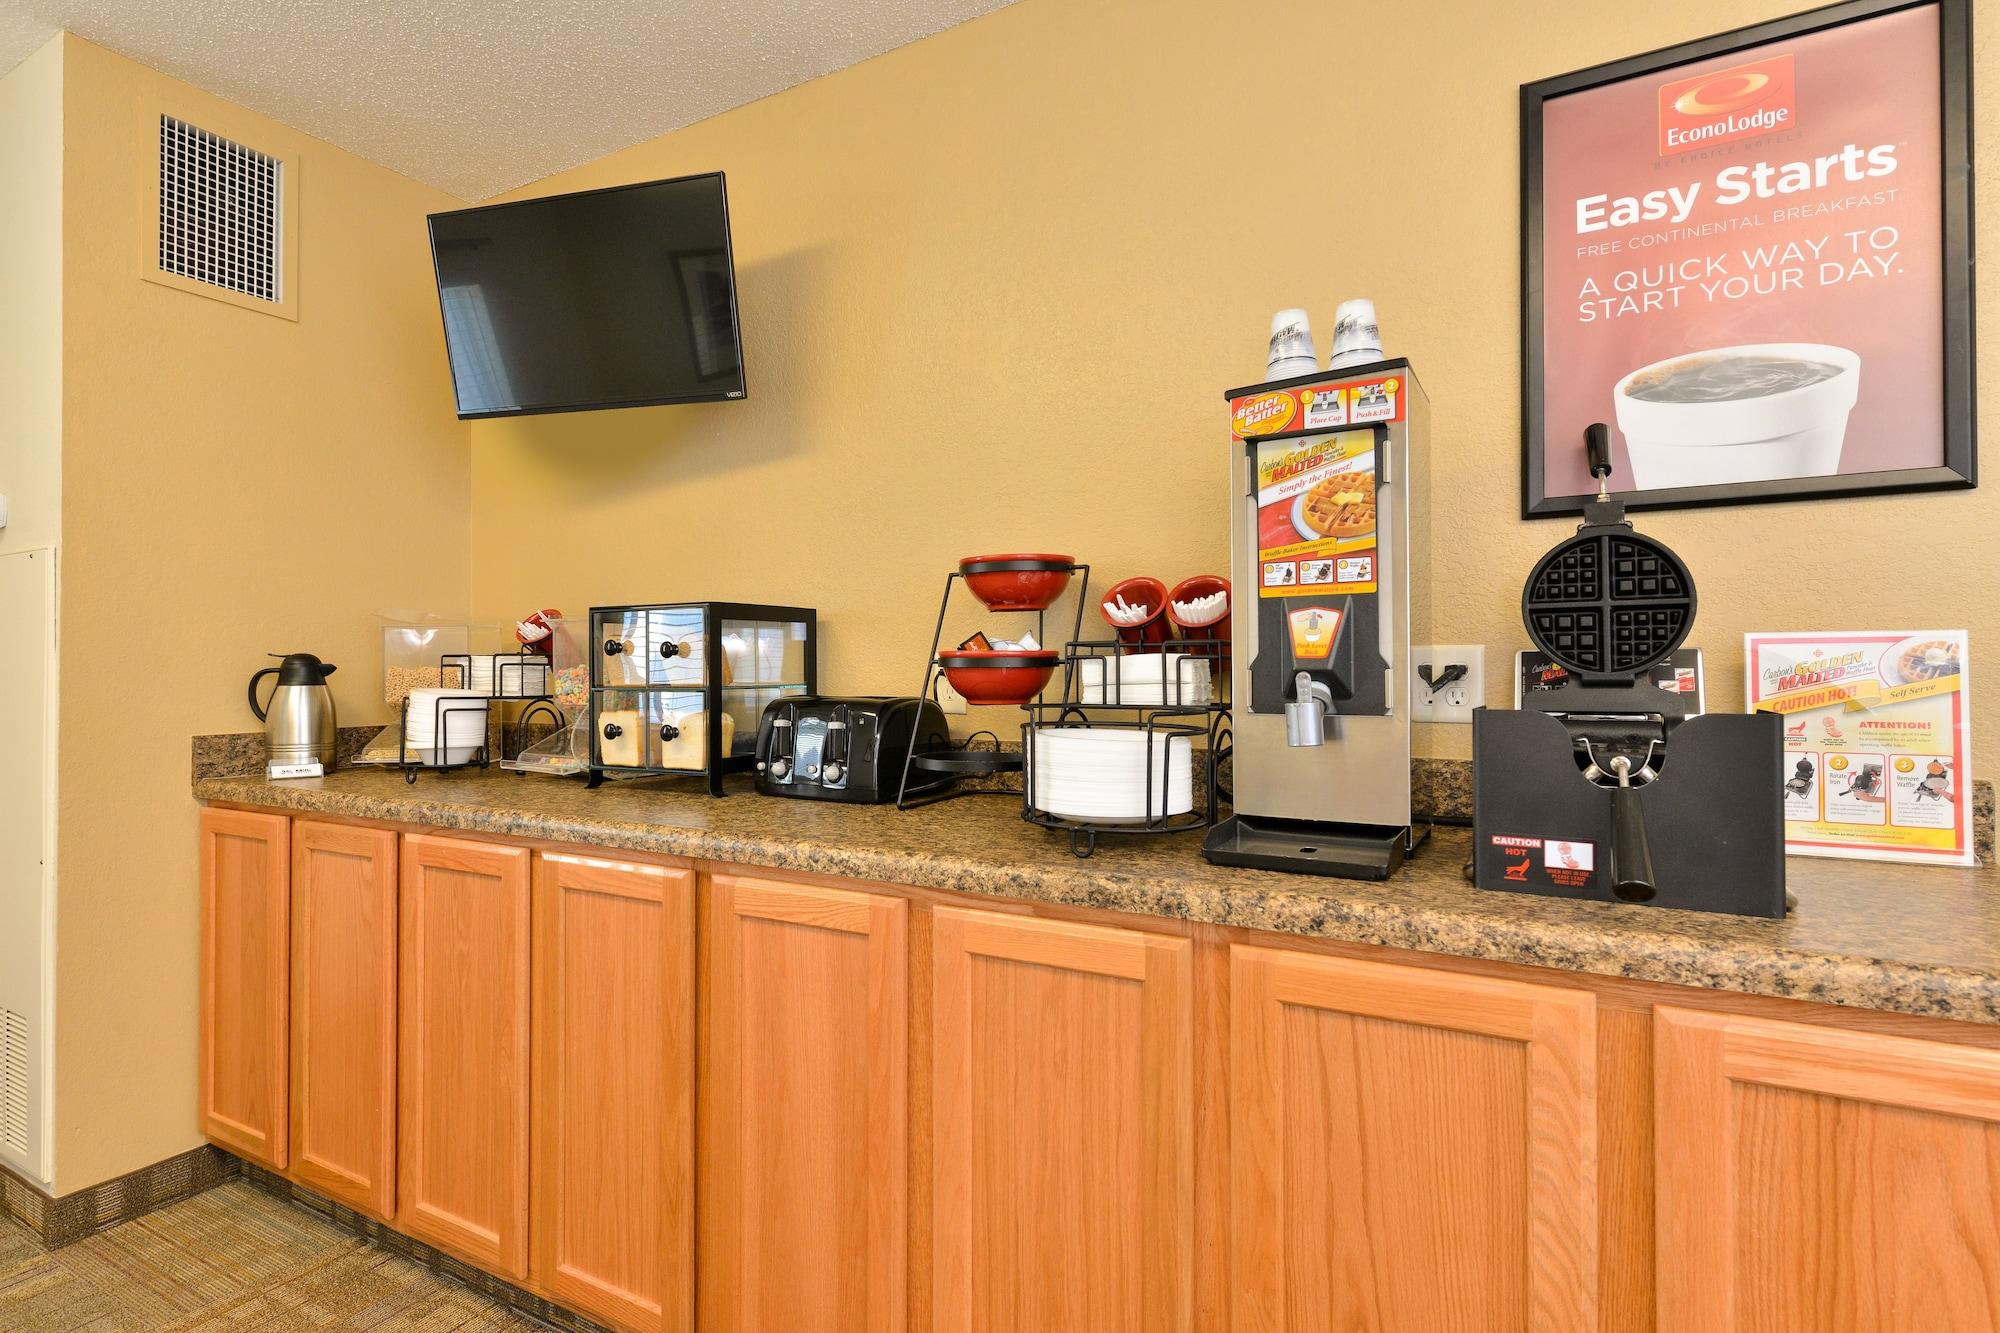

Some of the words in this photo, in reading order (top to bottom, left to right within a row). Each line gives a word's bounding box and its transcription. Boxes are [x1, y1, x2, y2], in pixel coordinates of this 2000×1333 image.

[1667, 107, 1788, 146] EconoLodge
[1680, 147, 1734, 164] CHOICE
[1745, 132, 1804, 150] HOTELS
[1576, 182, 1701, 234] Easy
[1715, 144, 1898, 205] Starts
[1577, 240, 1622, 259] FREE
[1628, 215, 1765, 249] CONTINENTAL
[1579, 277, 1601, 299] A
[1614, 253, 1728, 292] QUICK
[1742, 236, 1829, 270] WAY
[1844, 226, 1899, 253] TO
[1579, 285, 1686, 322] START
[1699, 268, 1804, 302] YOUR
[1819, 251, 1904, 286] DAY.
[1236, 395, 1280, 420] Better
[1244, 401, 1288, 426] Batter
[1310, 416, 1327, 425] Place
[1328, 415, 1342, 424] Cup
[1379, 408, 1391, 416] Fill
[1284, 437, 1338, 465] GOLDEN
[1272, 454, 1324, 482] MALTED
[1279, 479, 1308, 495] Simply
[1309, 472, 1322, 483] the
[1324, 461, 1353, 479] Finest!
[1794, 650, 1864, 675] GOLDEN
[1777, 666, 1846, 691] MALTED
[1889, 688, 1909, 699] Self
[1909, 684, 1936, 695] Serve
[1772, 690, 1825, 713] CAUTION
[1827, 685, 1857, 703] HOT!
[1859, 721, 1932, 730] ATTENTION!
[1492, 836, 1541, 847] CAUTION
[1504, 848, 1527, 856] HOT
